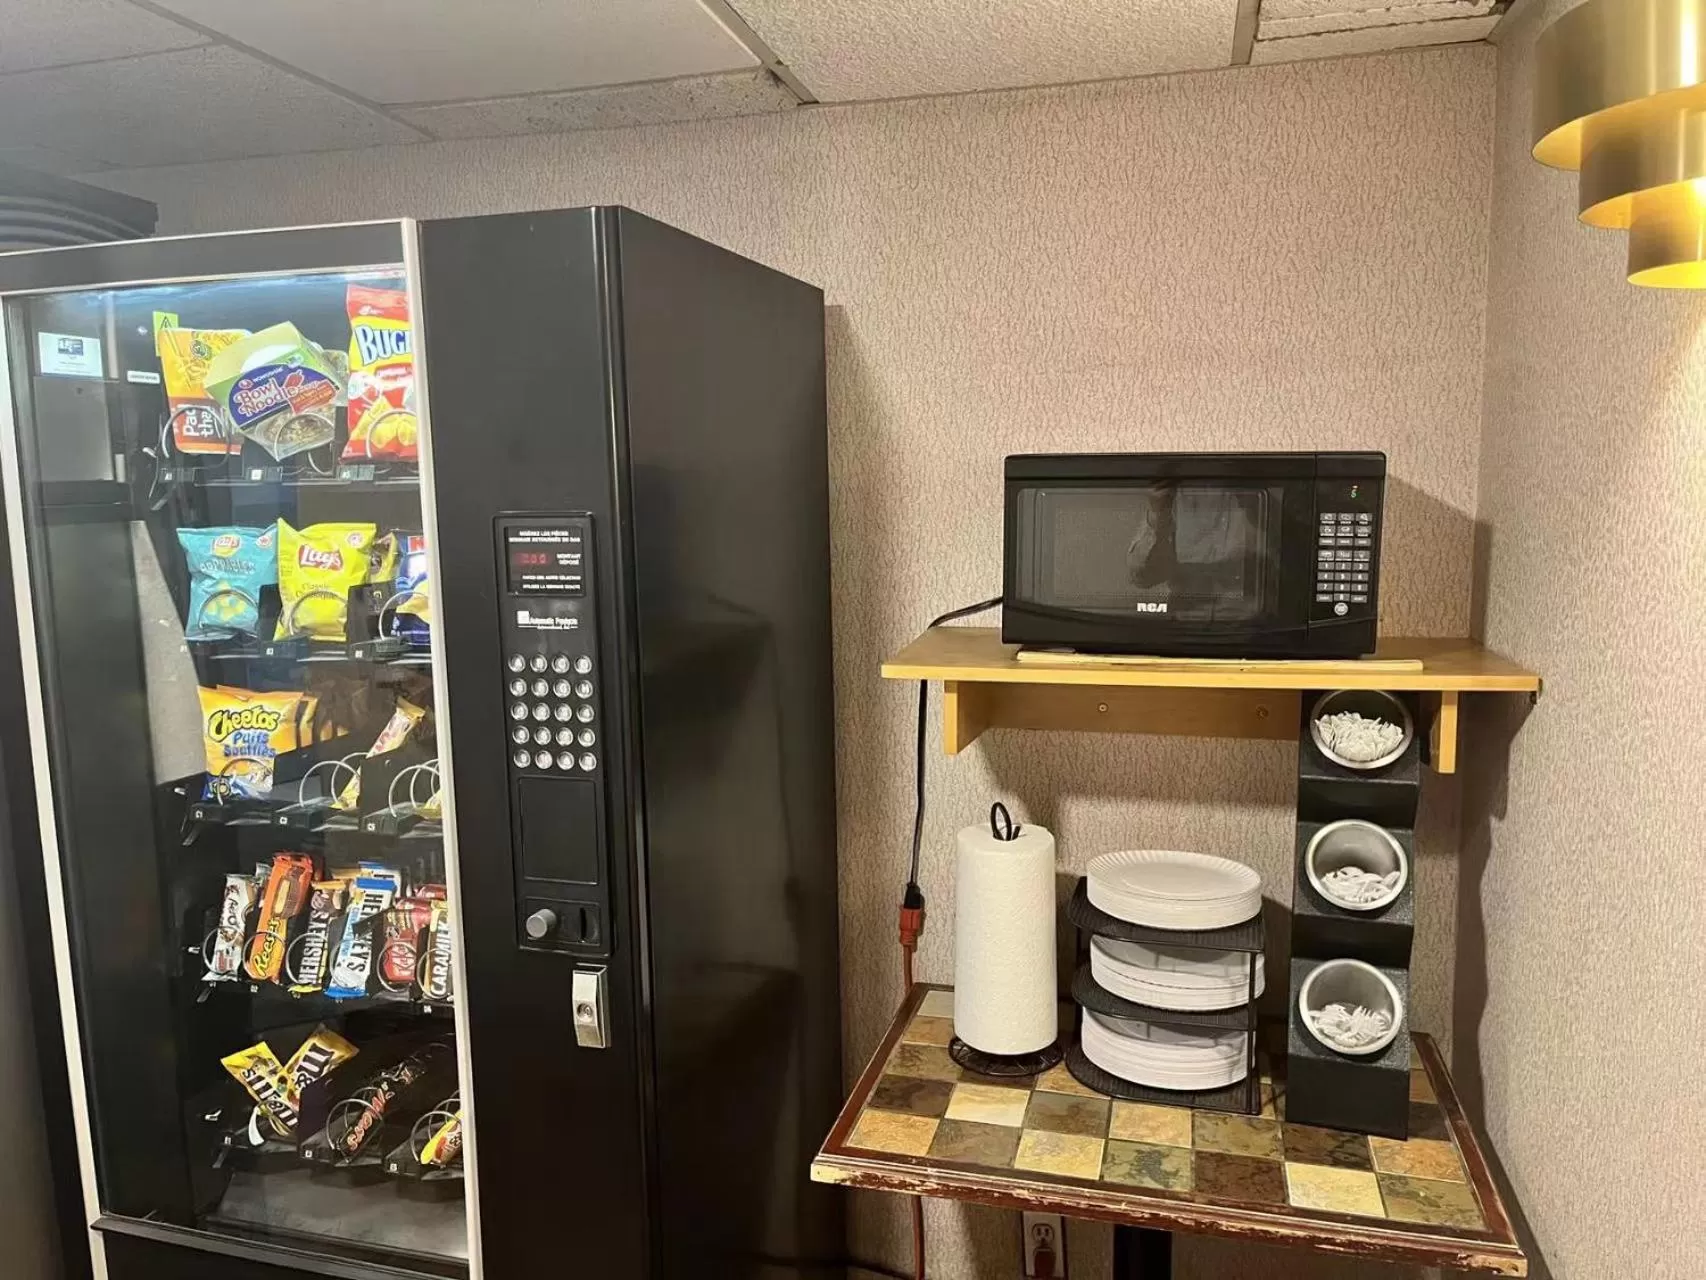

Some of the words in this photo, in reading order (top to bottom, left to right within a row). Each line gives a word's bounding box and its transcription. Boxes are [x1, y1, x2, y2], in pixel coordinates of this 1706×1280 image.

[1137, 602, 1168, 613] RCA
[207, 705, 281, 743] Cheetos
[233, 731, 270, 745] Puffs
[298, 908, 331, 985] HERSHEY'S
